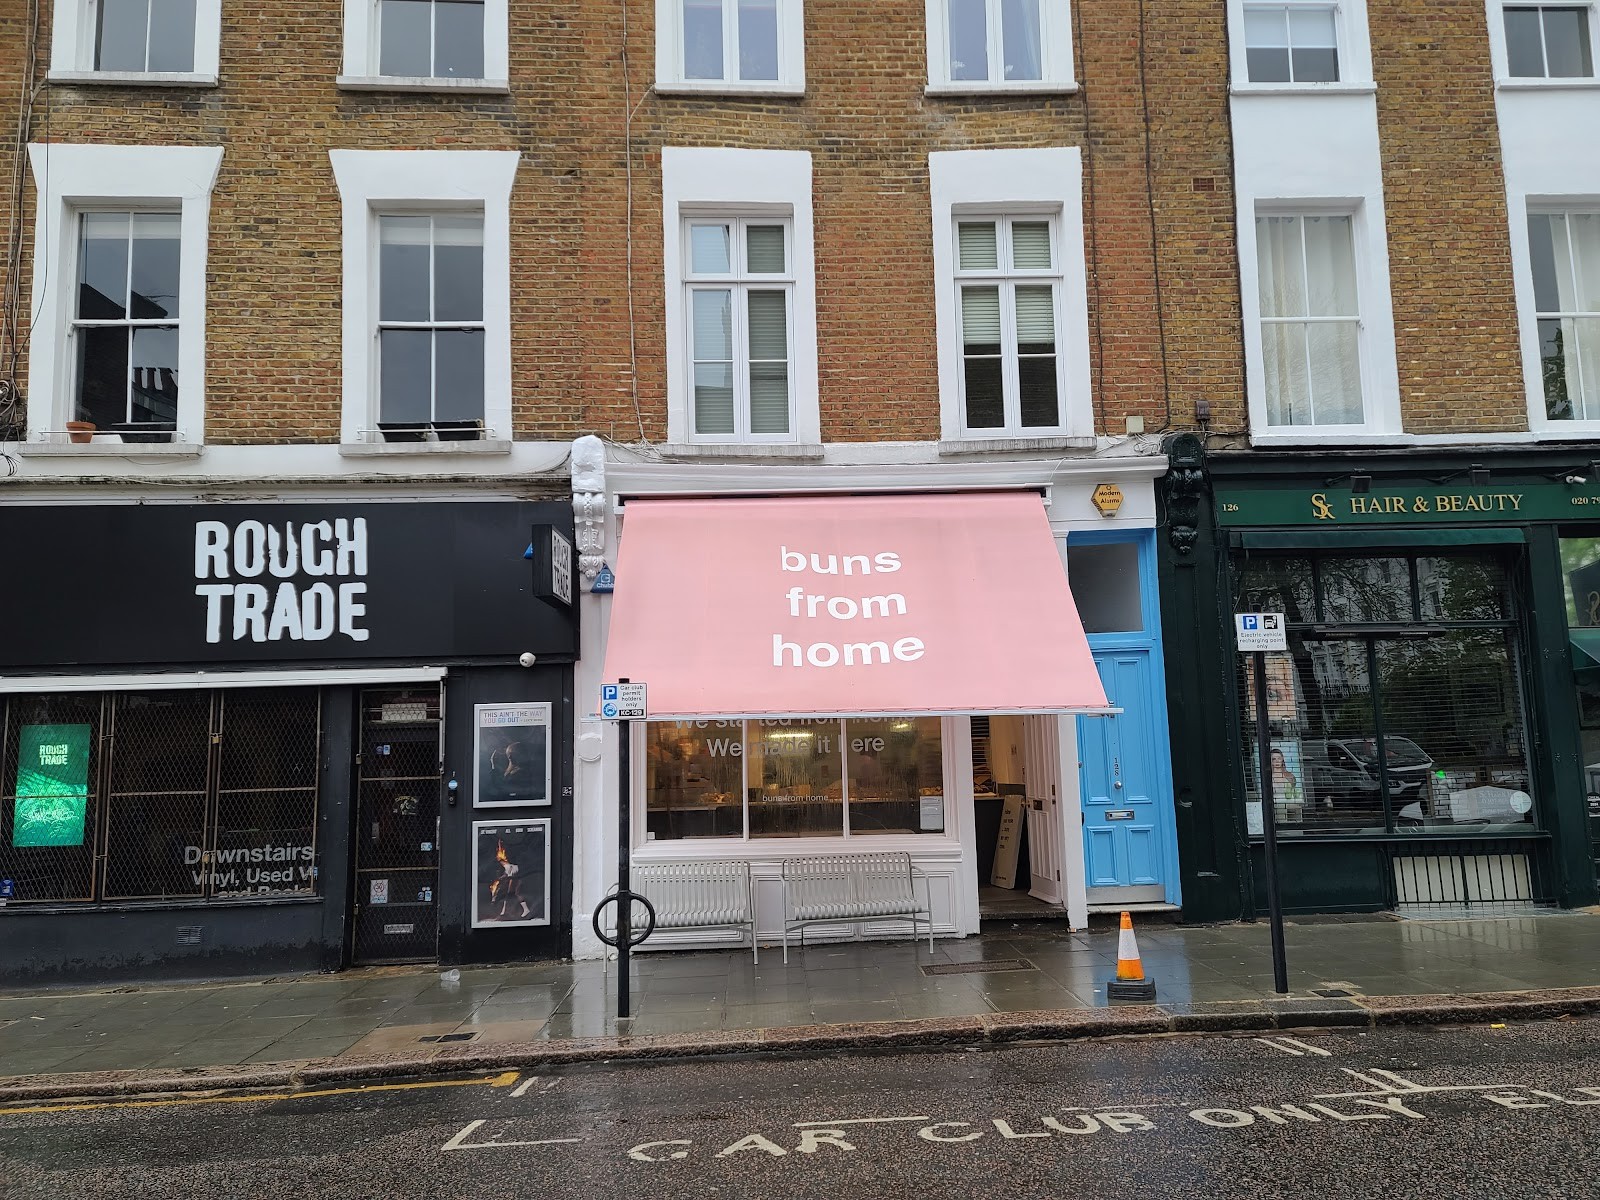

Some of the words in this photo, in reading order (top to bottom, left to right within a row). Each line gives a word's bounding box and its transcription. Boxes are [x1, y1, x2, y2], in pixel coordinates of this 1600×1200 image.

[1222, 504, 1239, 512] 126
[1350, 497, 1408, 514] HAIR
[1412, 496, 1430, 513] &
[1435, 493, 1524, 512] BEAUTY
[1571, 496, 1589, 505] 020
[194, 517, 368, 579] ROUGH
[780, 545, 902, 576] buns
[785, 586, 907, 620] from
[195, 581, 370, 644] TRADE
[1246, 616, 1256, 629] P
[772, 633, 925, 668] home
[605, 687, 616, 700] P
[39, 744, 68, 755] ROUGH
[706, 738, 742, 757] We
[748, 738, 811, 756] made
[817, 735, 831, 754] it
[39, 755, 68, 766] TRADE
[762, 794, 783, 802] buns
[805, 794, 829, 802] home
[246, 867, 293, 883] Used
[627, 1129, 856, 1162] CAR
[917, 1112, 1157, 1142] CLUB
[1188, 1097, 1426, 1128] ONLY
